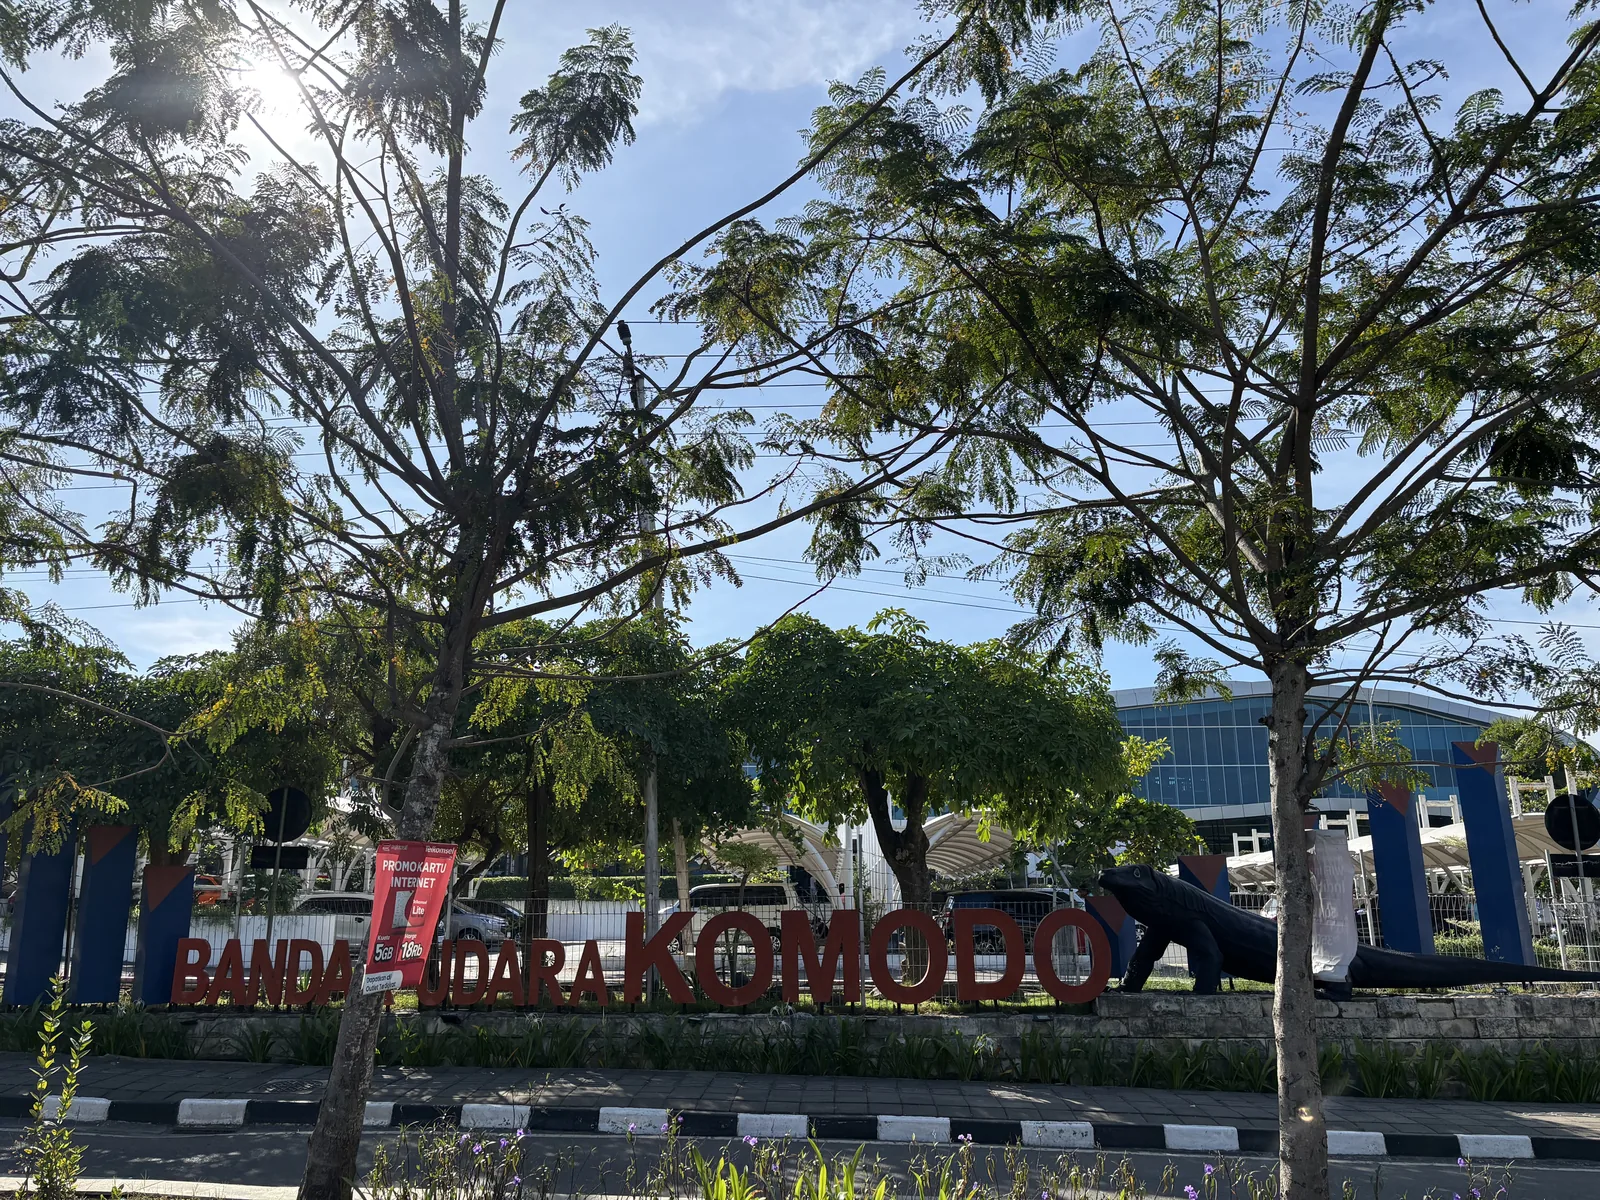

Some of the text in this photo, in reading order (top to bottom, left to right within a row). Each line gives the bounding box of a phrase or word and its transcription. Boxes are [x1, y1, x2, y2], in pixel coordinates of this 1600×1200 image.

[425, 845, 455, 855] Telkomsel
[391, 877, 436, 888] INTERNET
[412, 905, 425, 915] Lite
[171, 908, 1112, 1007] BANDA UDARA KOMODO
[374, 943, 394, 962] 5GB
[401, 941, 423, 960] 18Rb
